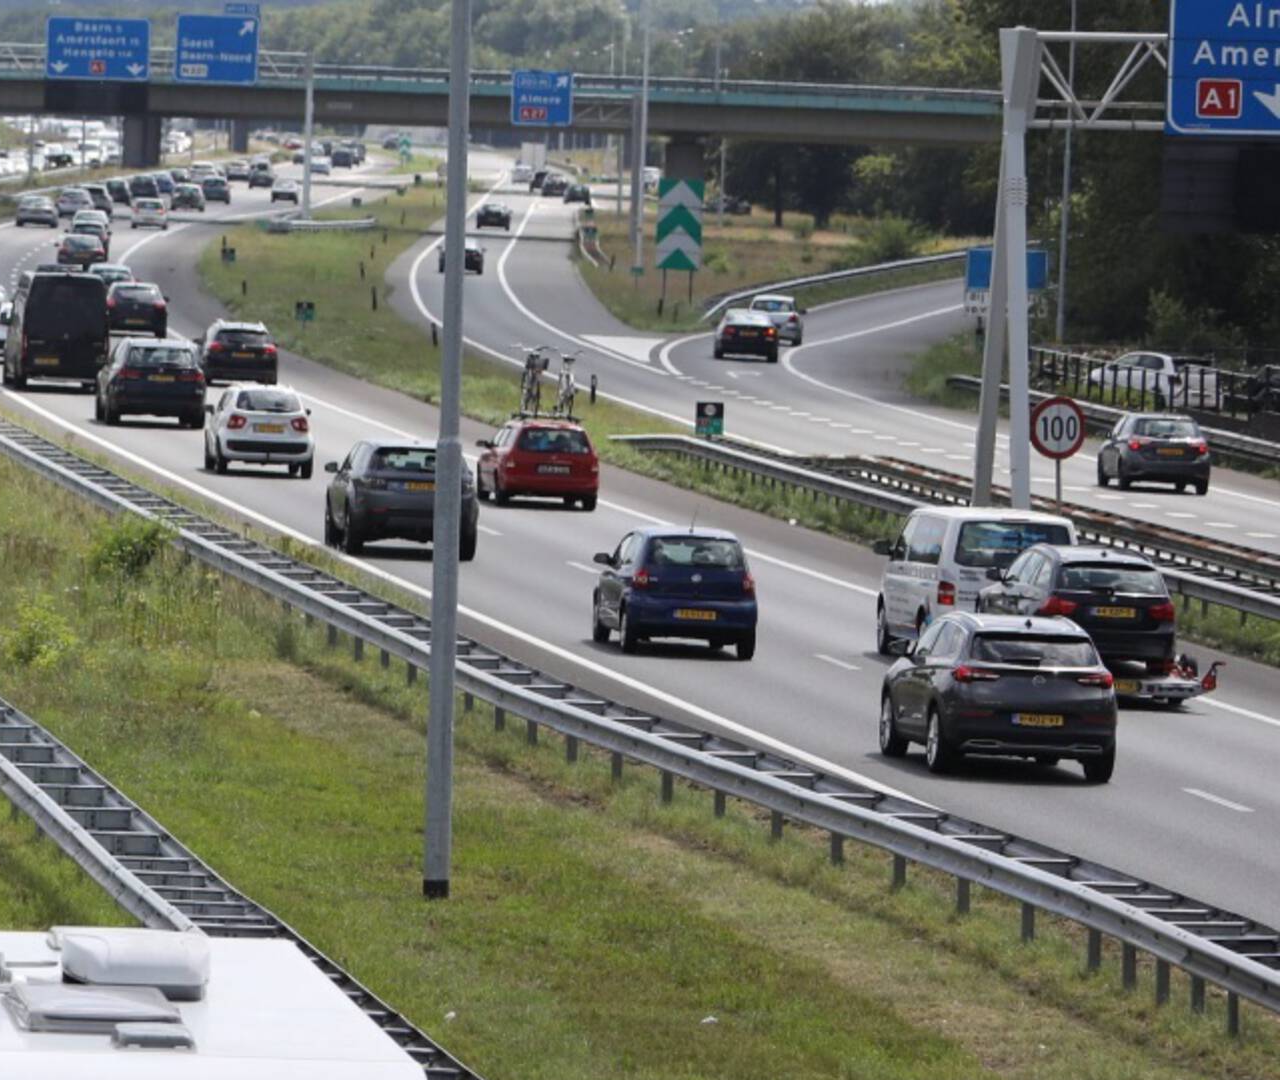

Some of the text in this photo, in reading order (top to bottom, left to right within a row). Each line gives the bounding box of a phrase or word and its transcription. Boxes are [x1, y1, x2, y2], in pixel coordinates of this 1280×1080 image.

[74, 21, 112, 33] Baarn
[56, 33, 127, 46] Amersfoort
[63, 47, 115, 59] Hengelo
[521, 93, 561, 106] Almere
[1201, 87, 1237, 109] A1
[1041, 415, 1078, 442] 100
